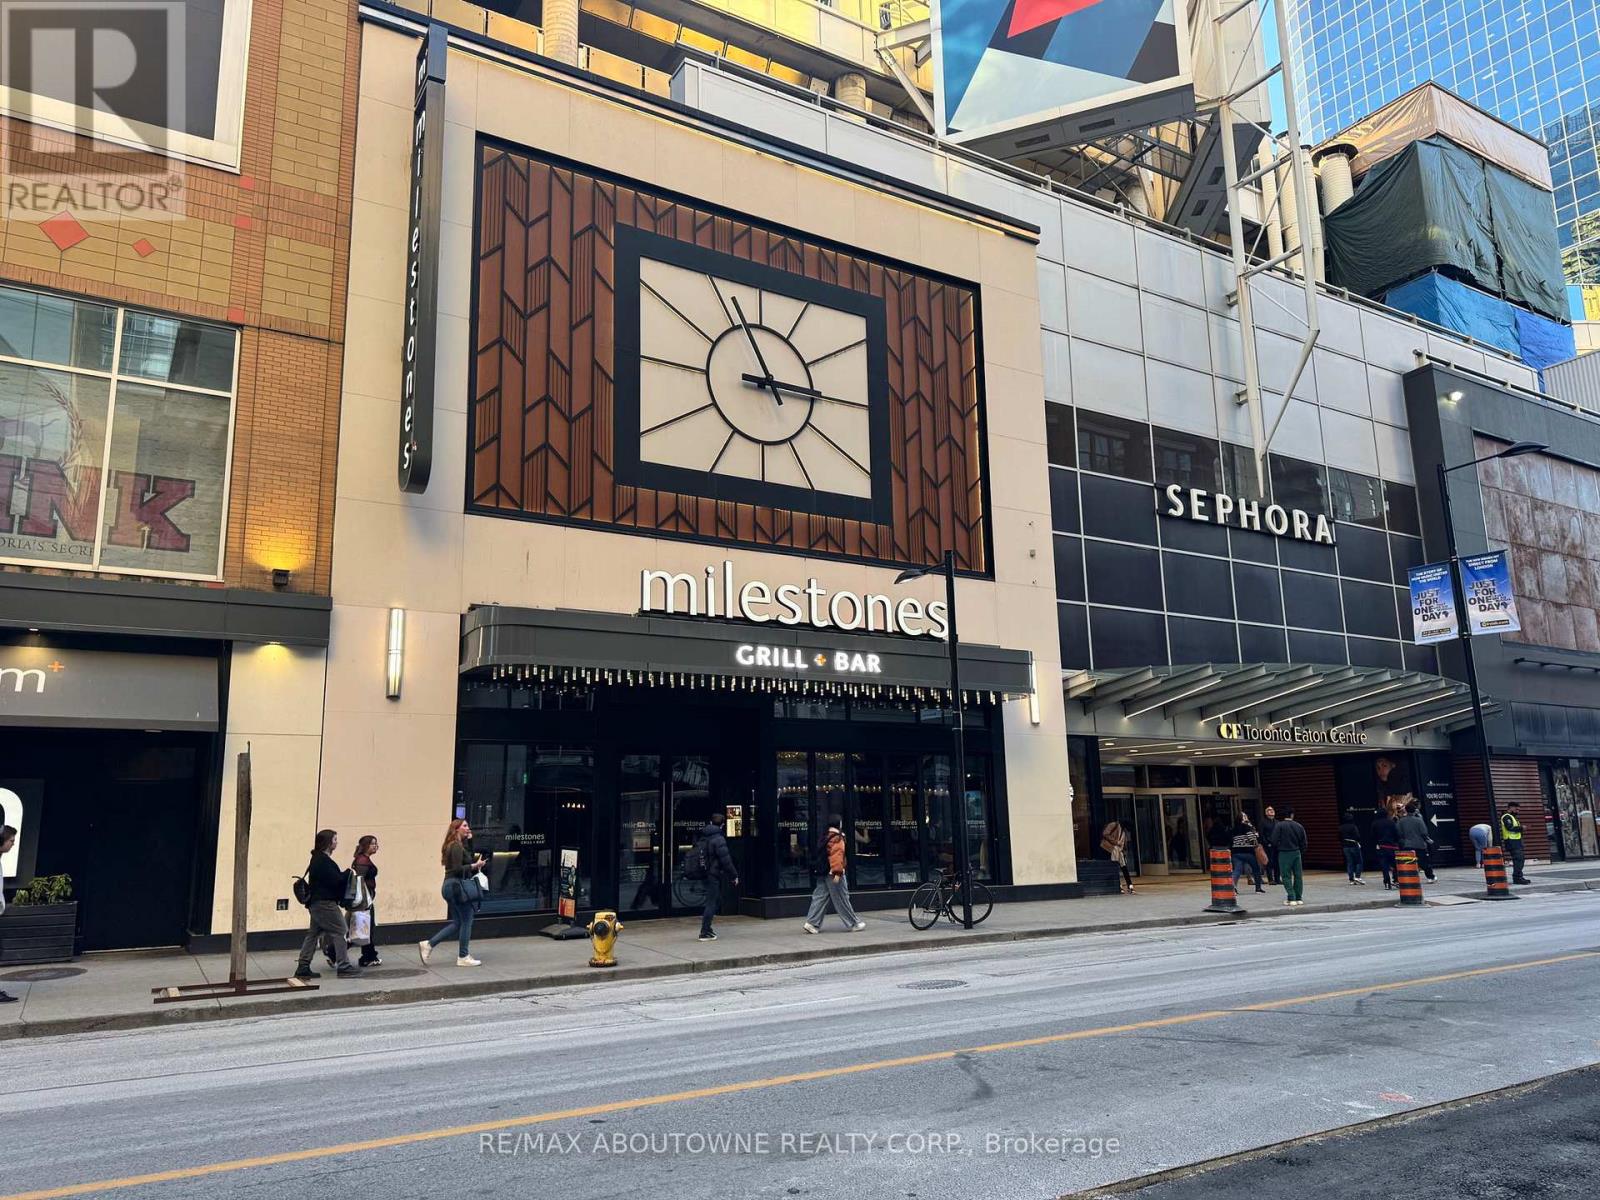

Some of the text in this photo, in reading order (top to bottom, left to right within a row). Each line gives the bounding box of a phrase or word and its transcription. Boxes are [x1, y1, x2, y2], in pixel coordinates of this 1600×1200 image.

[404, 109, 426, 470] milestones
[1166, 484, 1333, 544] SEPHORA
[1469, 580, 1497, 590] JUST
[1414, 590, 1439, 601] JUST
[1475, 588, 1496, 597] FOR
[641, 560, 949, 637] milestones
[1419, 597, 1438, 607] FOR
[1468, 595, 1492, 606] ONE
[1414, 606, 1435, 616] ONE
[1479, 602, 1501, 613] DAY
[1422, 611, 1441, 622] DAY
[735, 644, 882, 673] GRILL BAR
[1219, 723, 1368, 745] CF Toronto Eaton Centre
[504, 832, 545, 841] milestones
